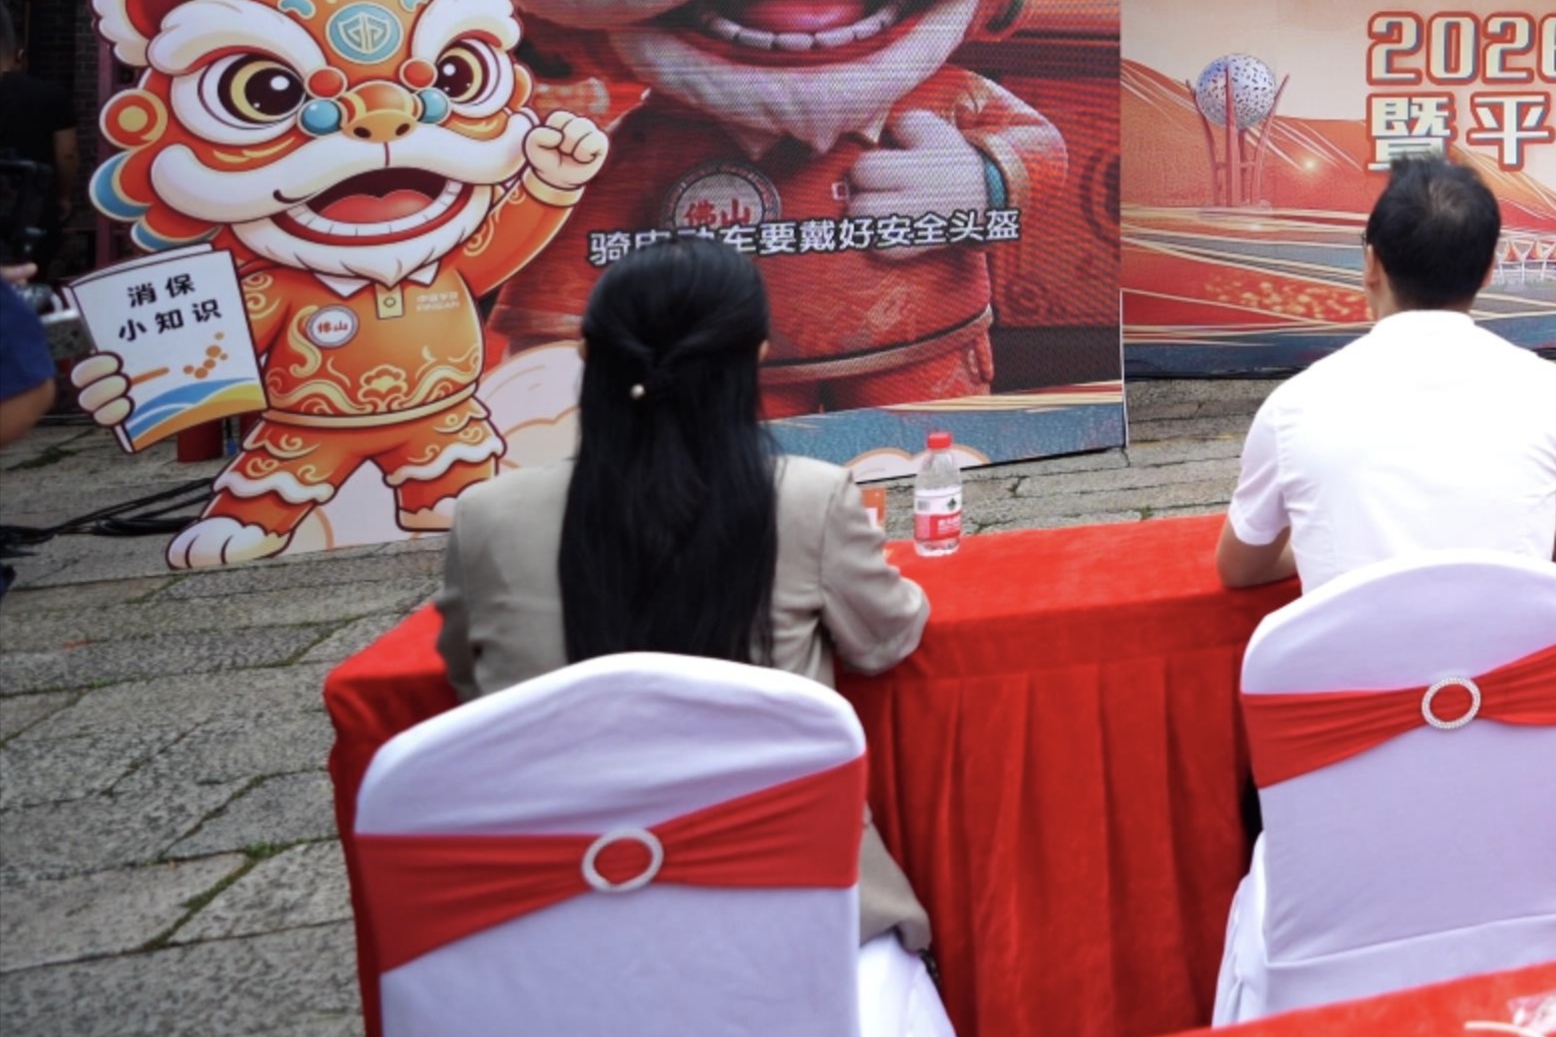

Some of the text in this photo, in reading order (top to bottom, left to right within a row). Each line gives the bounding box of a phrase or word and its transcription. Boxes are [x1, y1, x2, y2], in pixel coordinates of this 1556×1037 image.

[127, 273, 196, 308] 消保
[119, 299, 223, 342] 小知识
